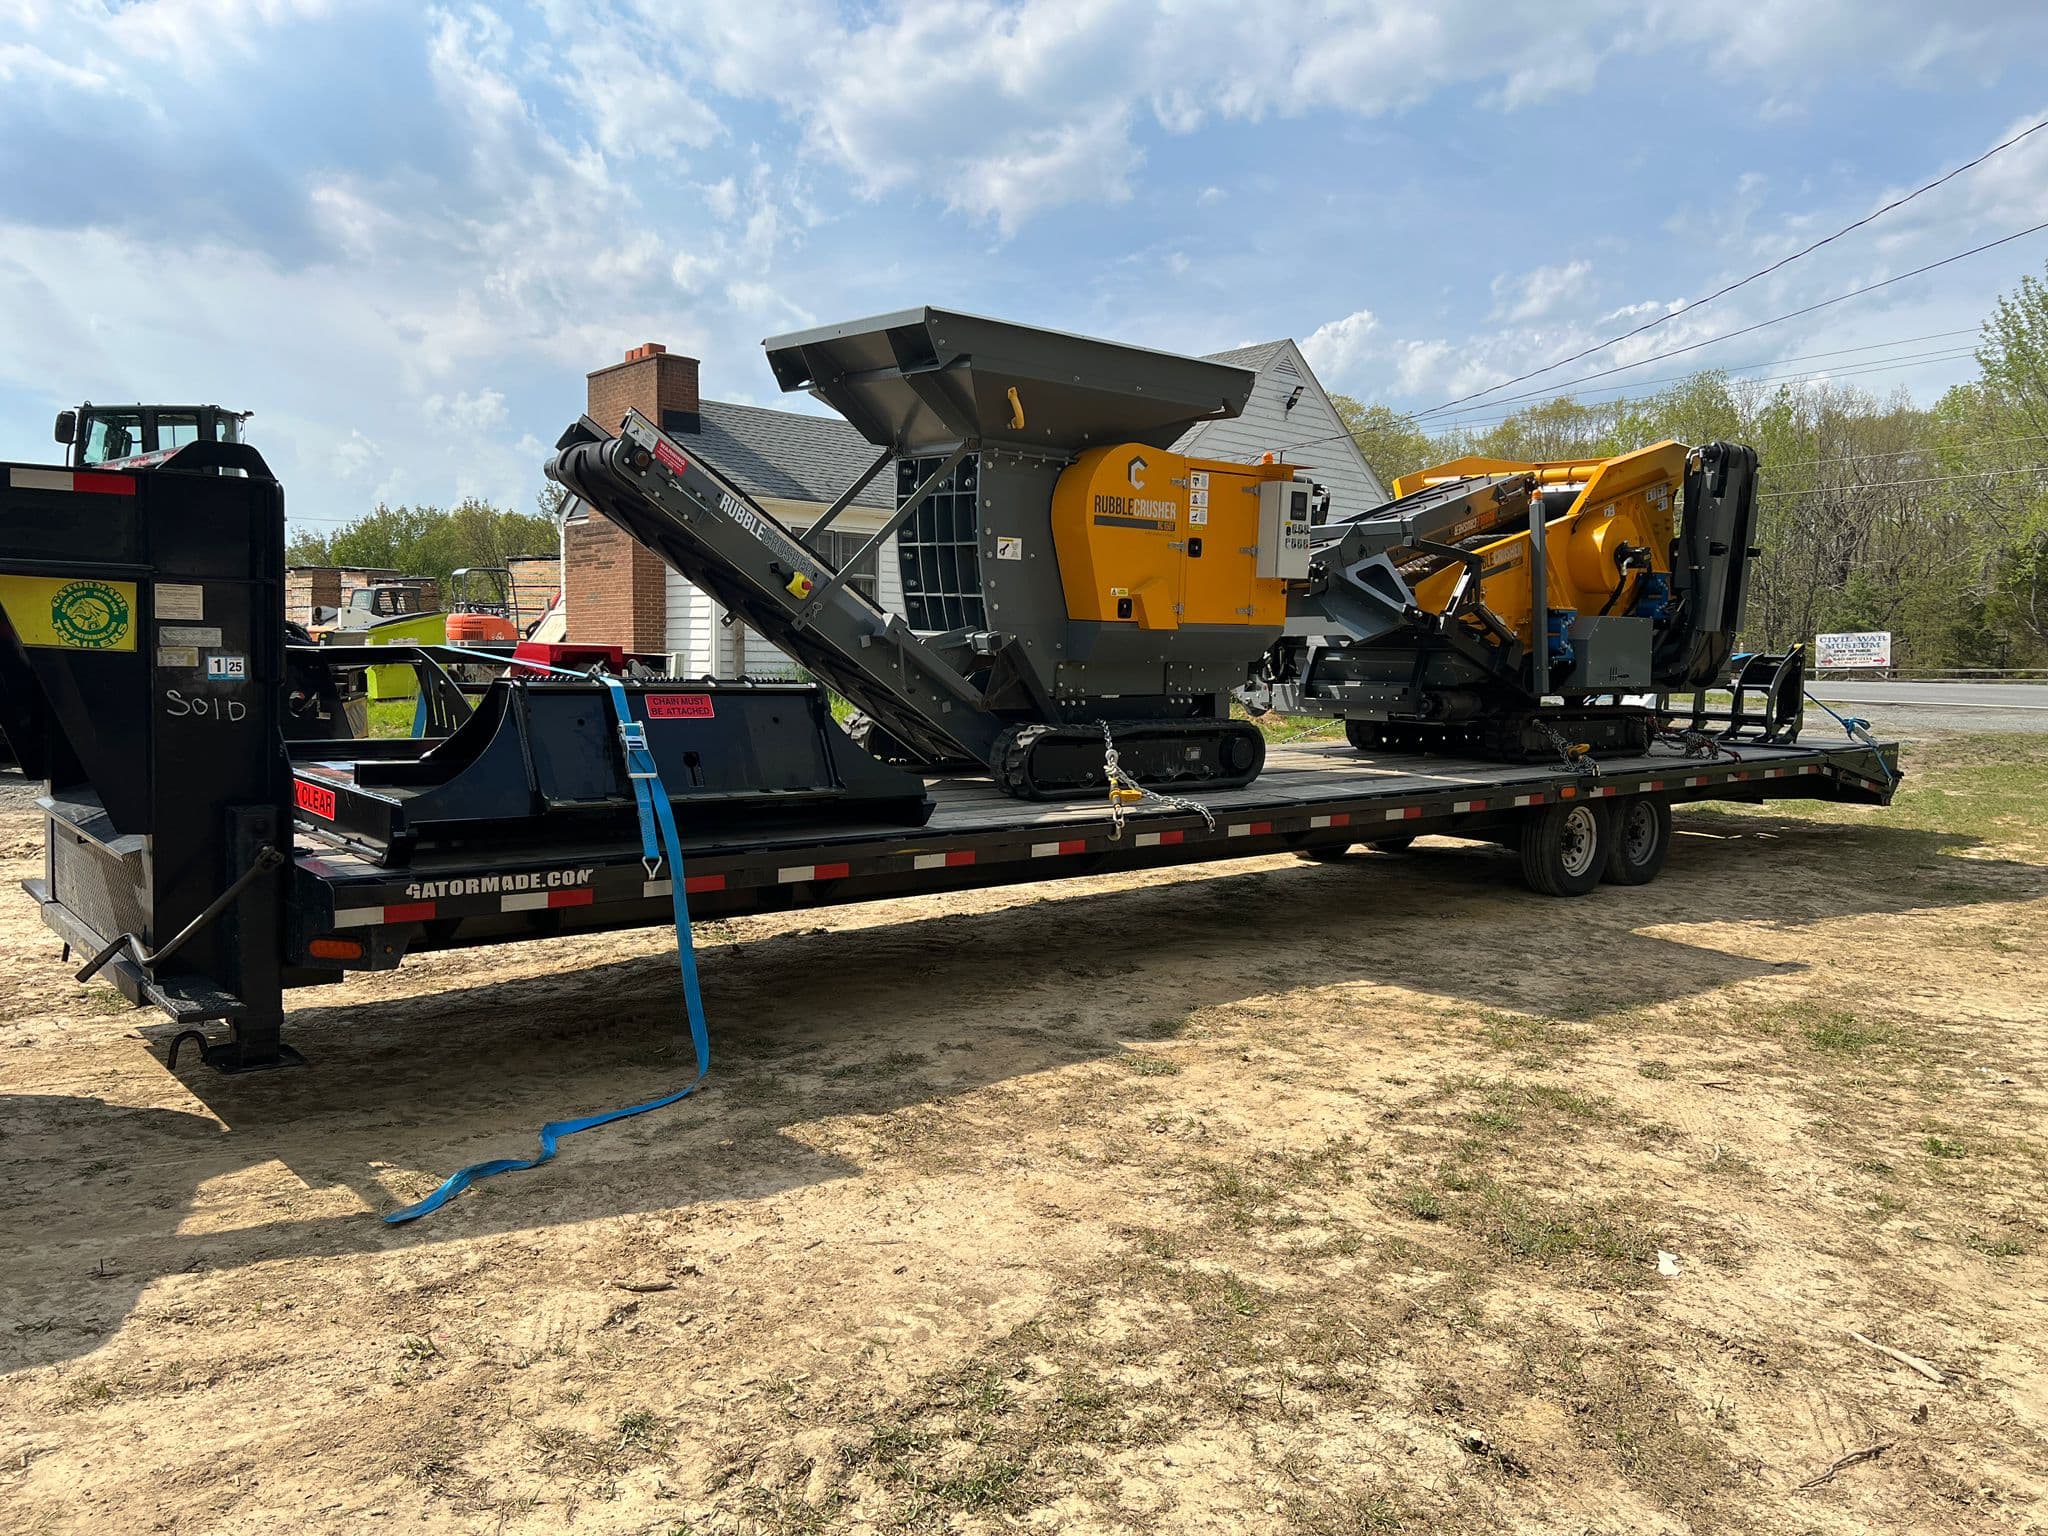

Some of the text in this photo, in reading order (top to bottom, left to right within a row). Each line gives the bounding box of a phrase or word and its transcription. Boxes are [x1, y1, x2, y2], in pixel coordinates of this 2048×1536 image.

[1094, 495, 1176, 519] RUBBLECRUSHER
[52, 619, 128, 649] TRAILERS
[214, 659, 242, 672] 1 25
[653, 697, 704, 705] CHAIN MUST
[651, 707, 710, 715] BE ATTACHED
[302, 786, 332, 815] CLEAR
